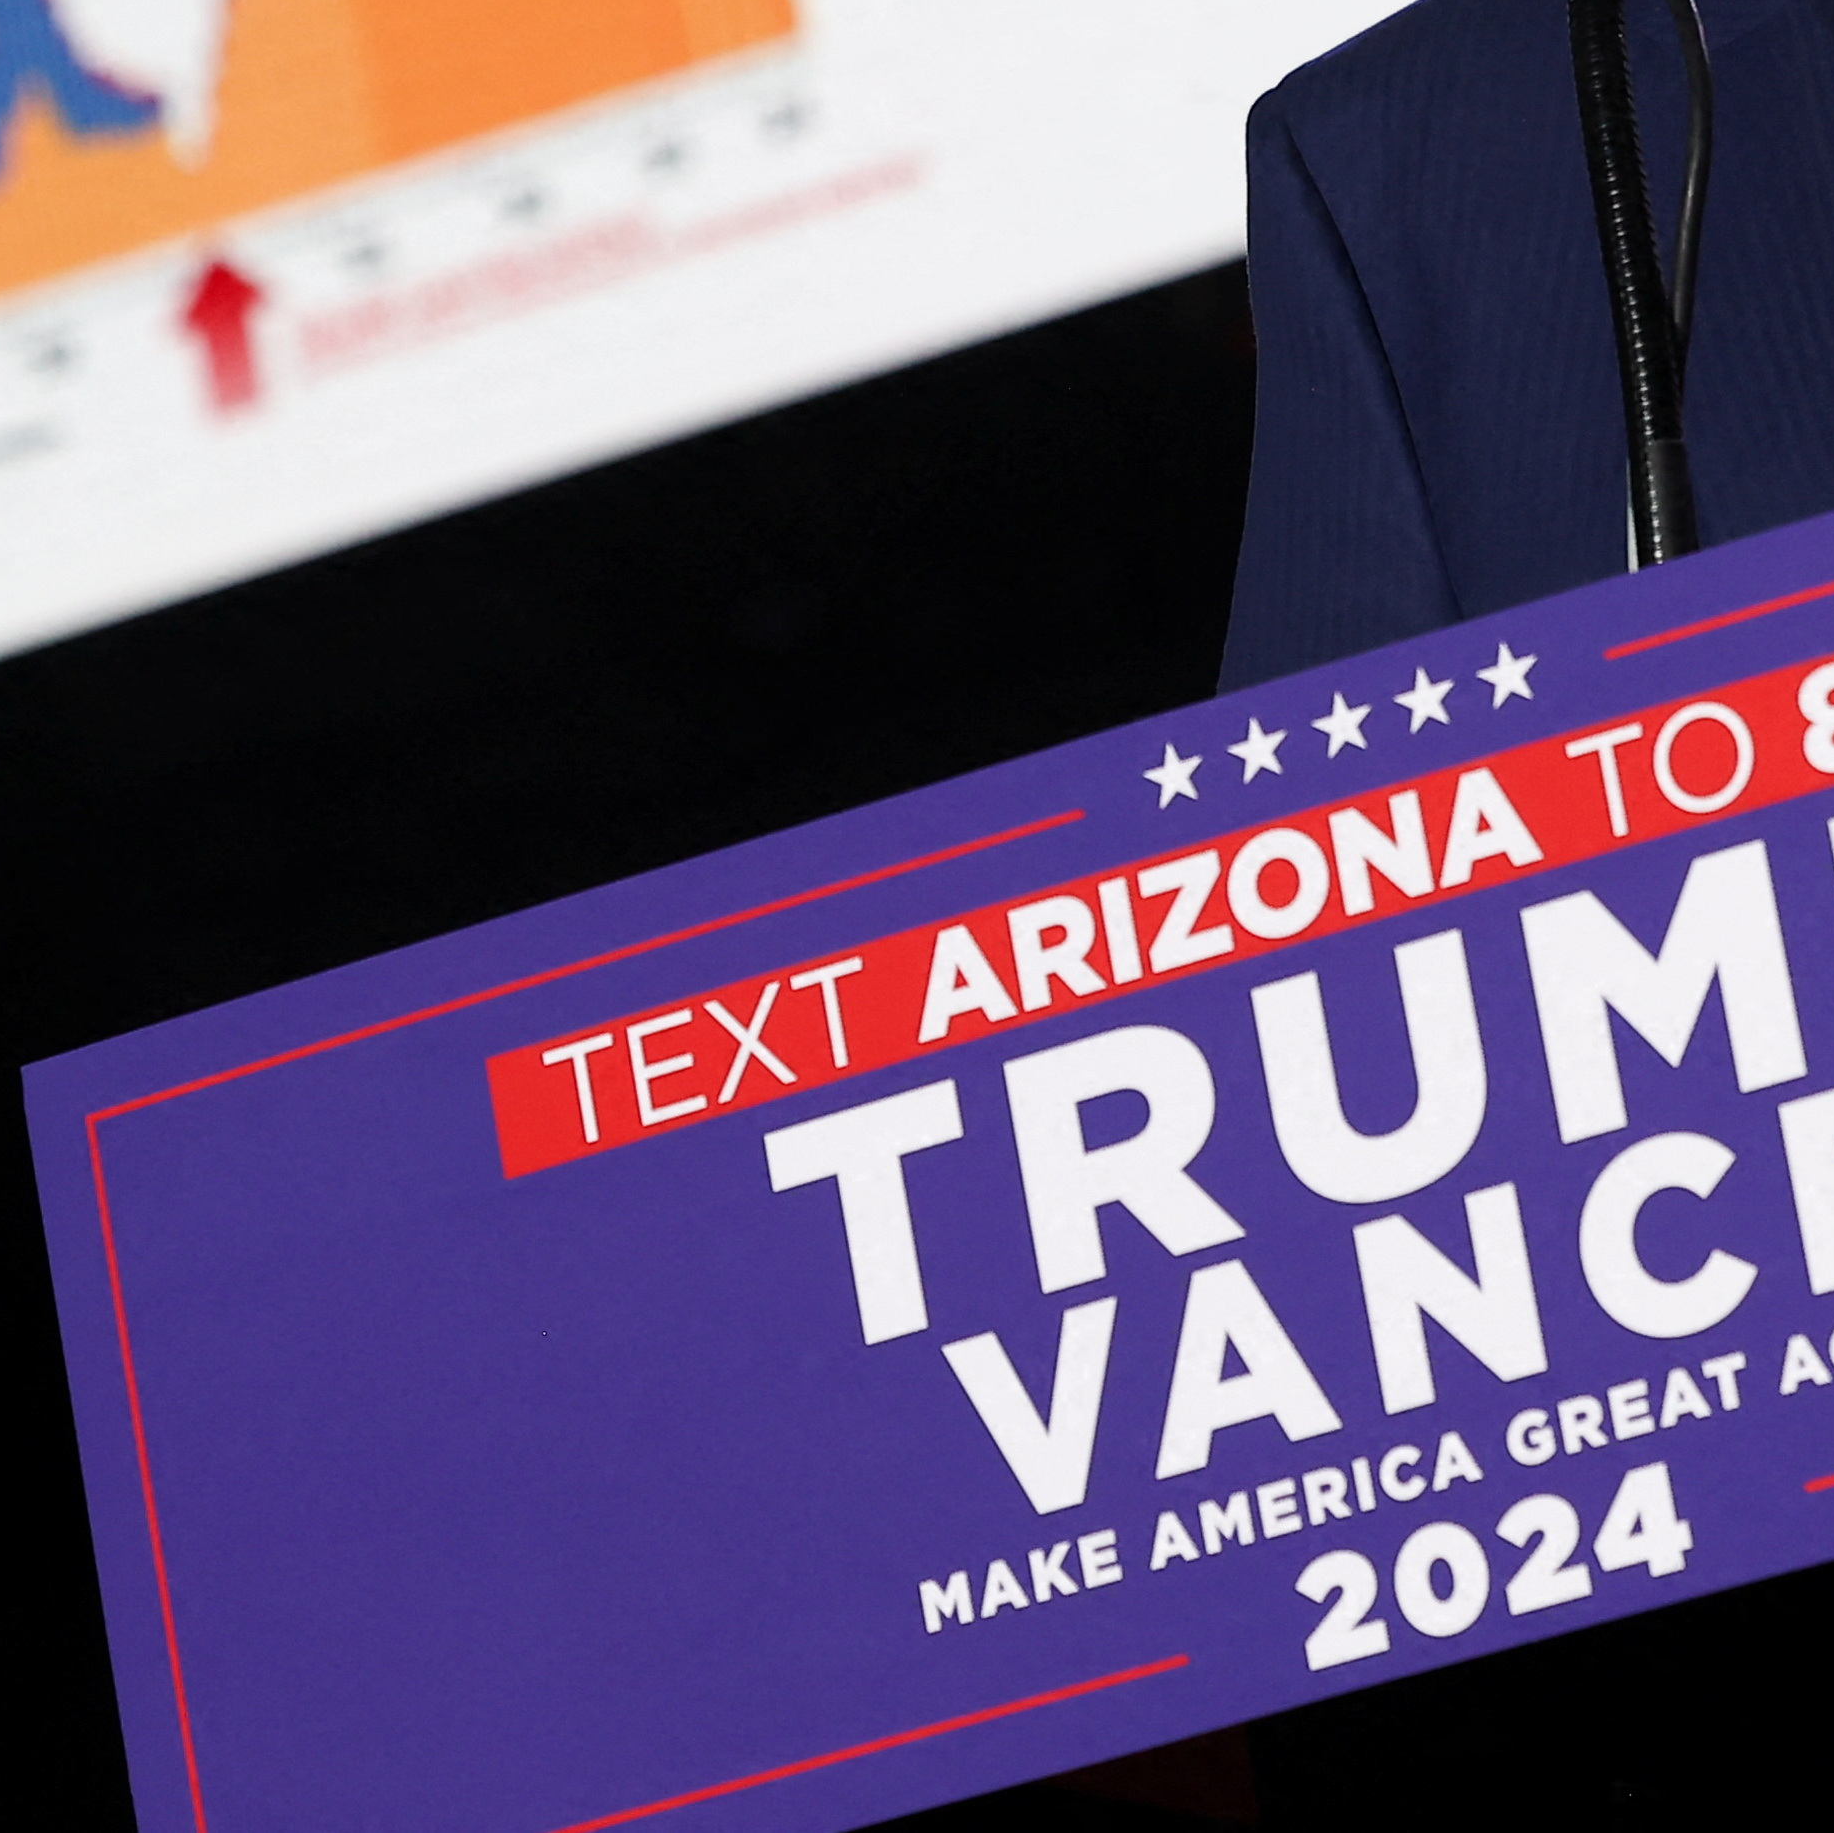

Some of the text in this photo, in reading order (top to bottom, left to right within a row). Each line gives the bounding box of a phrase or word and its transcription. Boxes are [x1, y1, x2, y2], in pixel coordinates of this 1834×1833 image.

[540, 955, 865, 1145] TEXT
[916, 766, 1545, 1046] ARIZONA
[1564, 700, 1756, 838] TO
[918, 1528, 1124, 1634] MAKE
[1148, 1430, 1485, 1573] AMERICA
[1505, 1350, 1748, 1468] GREAT
[1294, 1460, 1695, 1671] 2024
